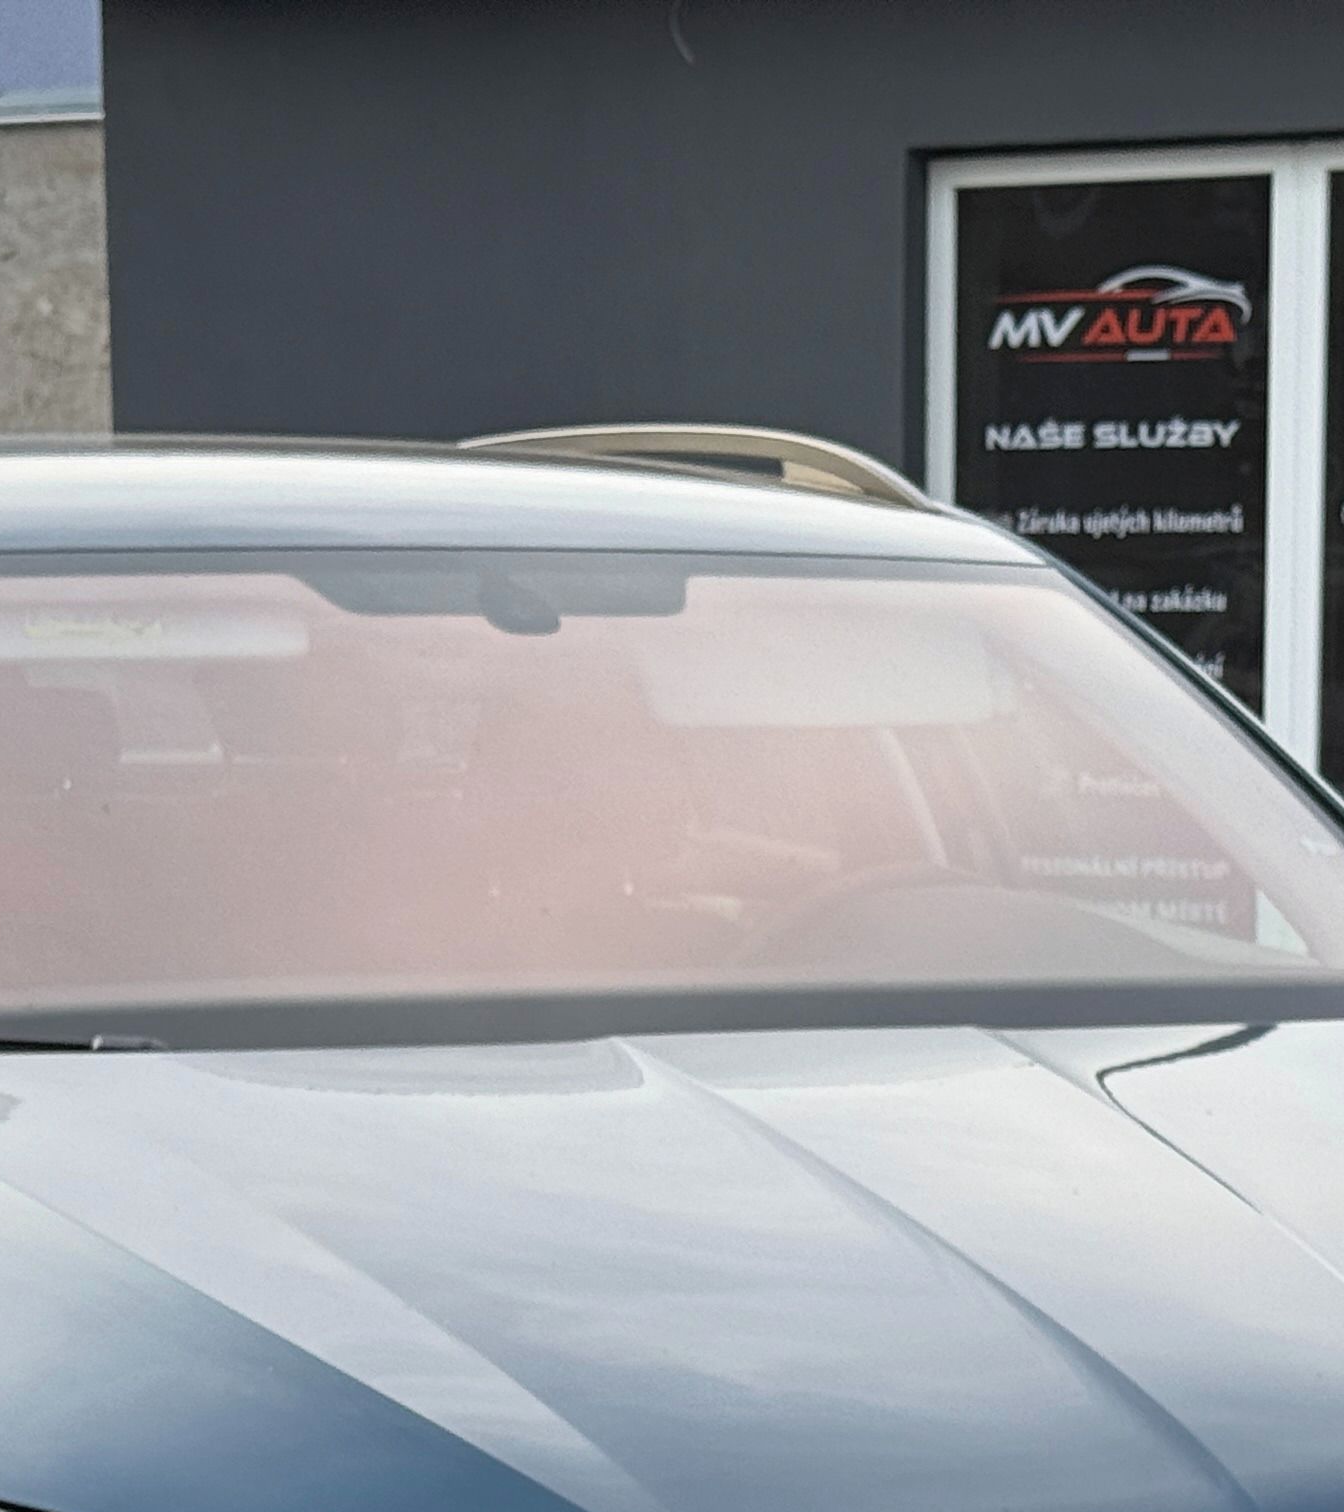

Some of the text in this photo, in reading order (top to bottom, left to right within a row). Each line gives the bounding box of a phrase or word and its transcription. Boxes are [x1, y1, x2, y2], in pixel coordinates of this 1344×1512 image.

[989, 307, 1237, 349] MV AUTA
[986, 415, 1240, 451] NAŠE SLUŽBY
